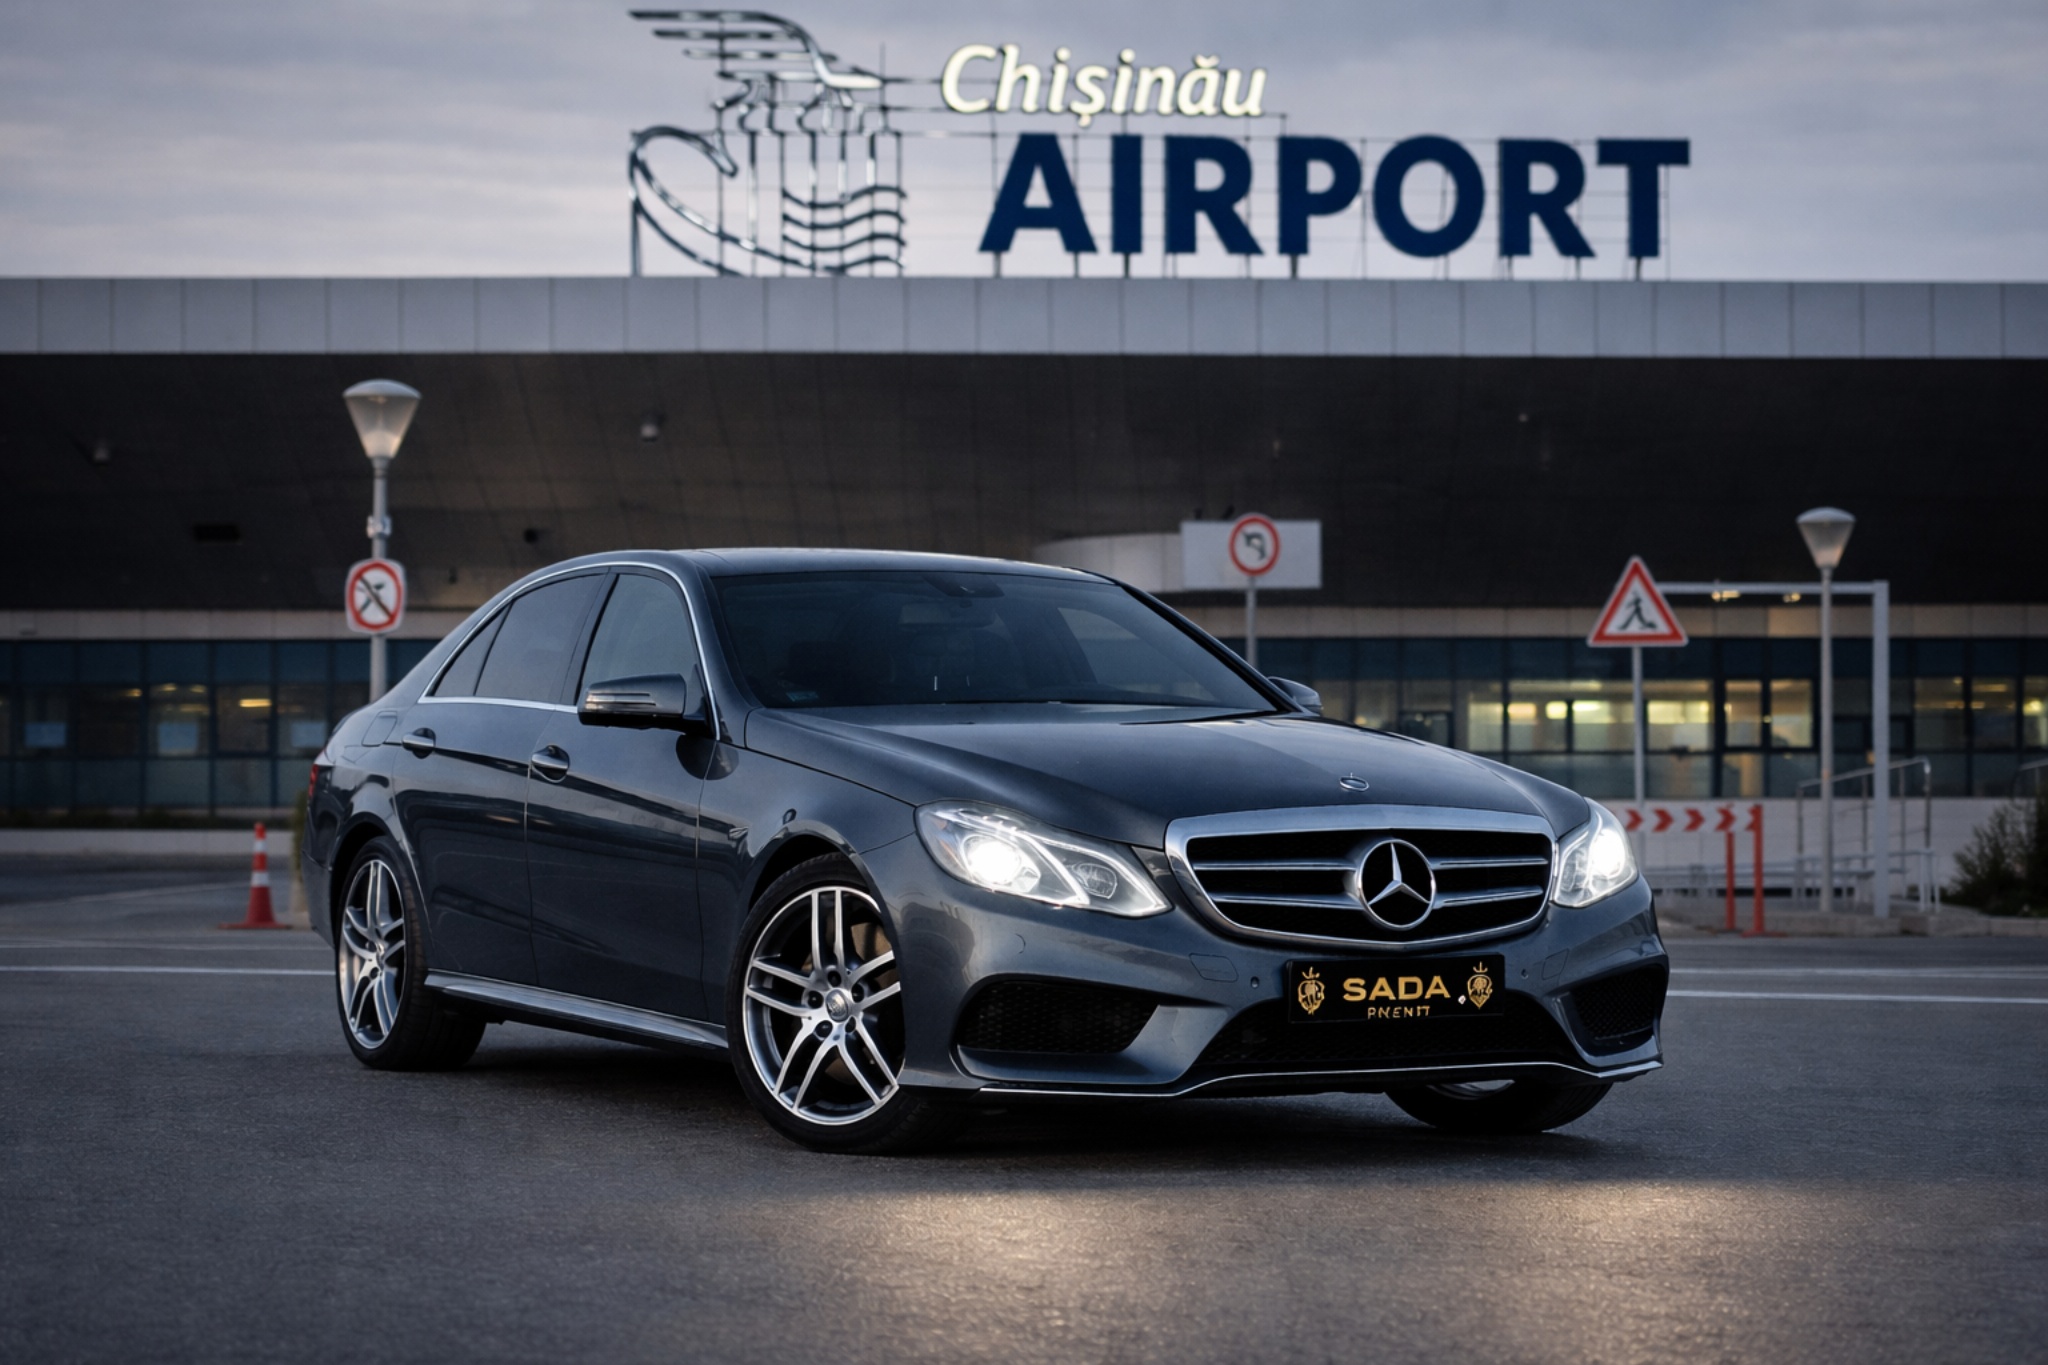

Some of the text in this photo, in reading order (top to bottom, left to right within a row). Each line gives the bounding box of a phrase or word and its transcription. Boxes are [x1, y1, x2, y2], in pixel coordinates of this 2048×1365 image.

[941, 43, 1267, 127] Chișinău
[978, 133, 1691, 258] AIRPORT
[1342, 975, 1451, 1002] SADA
